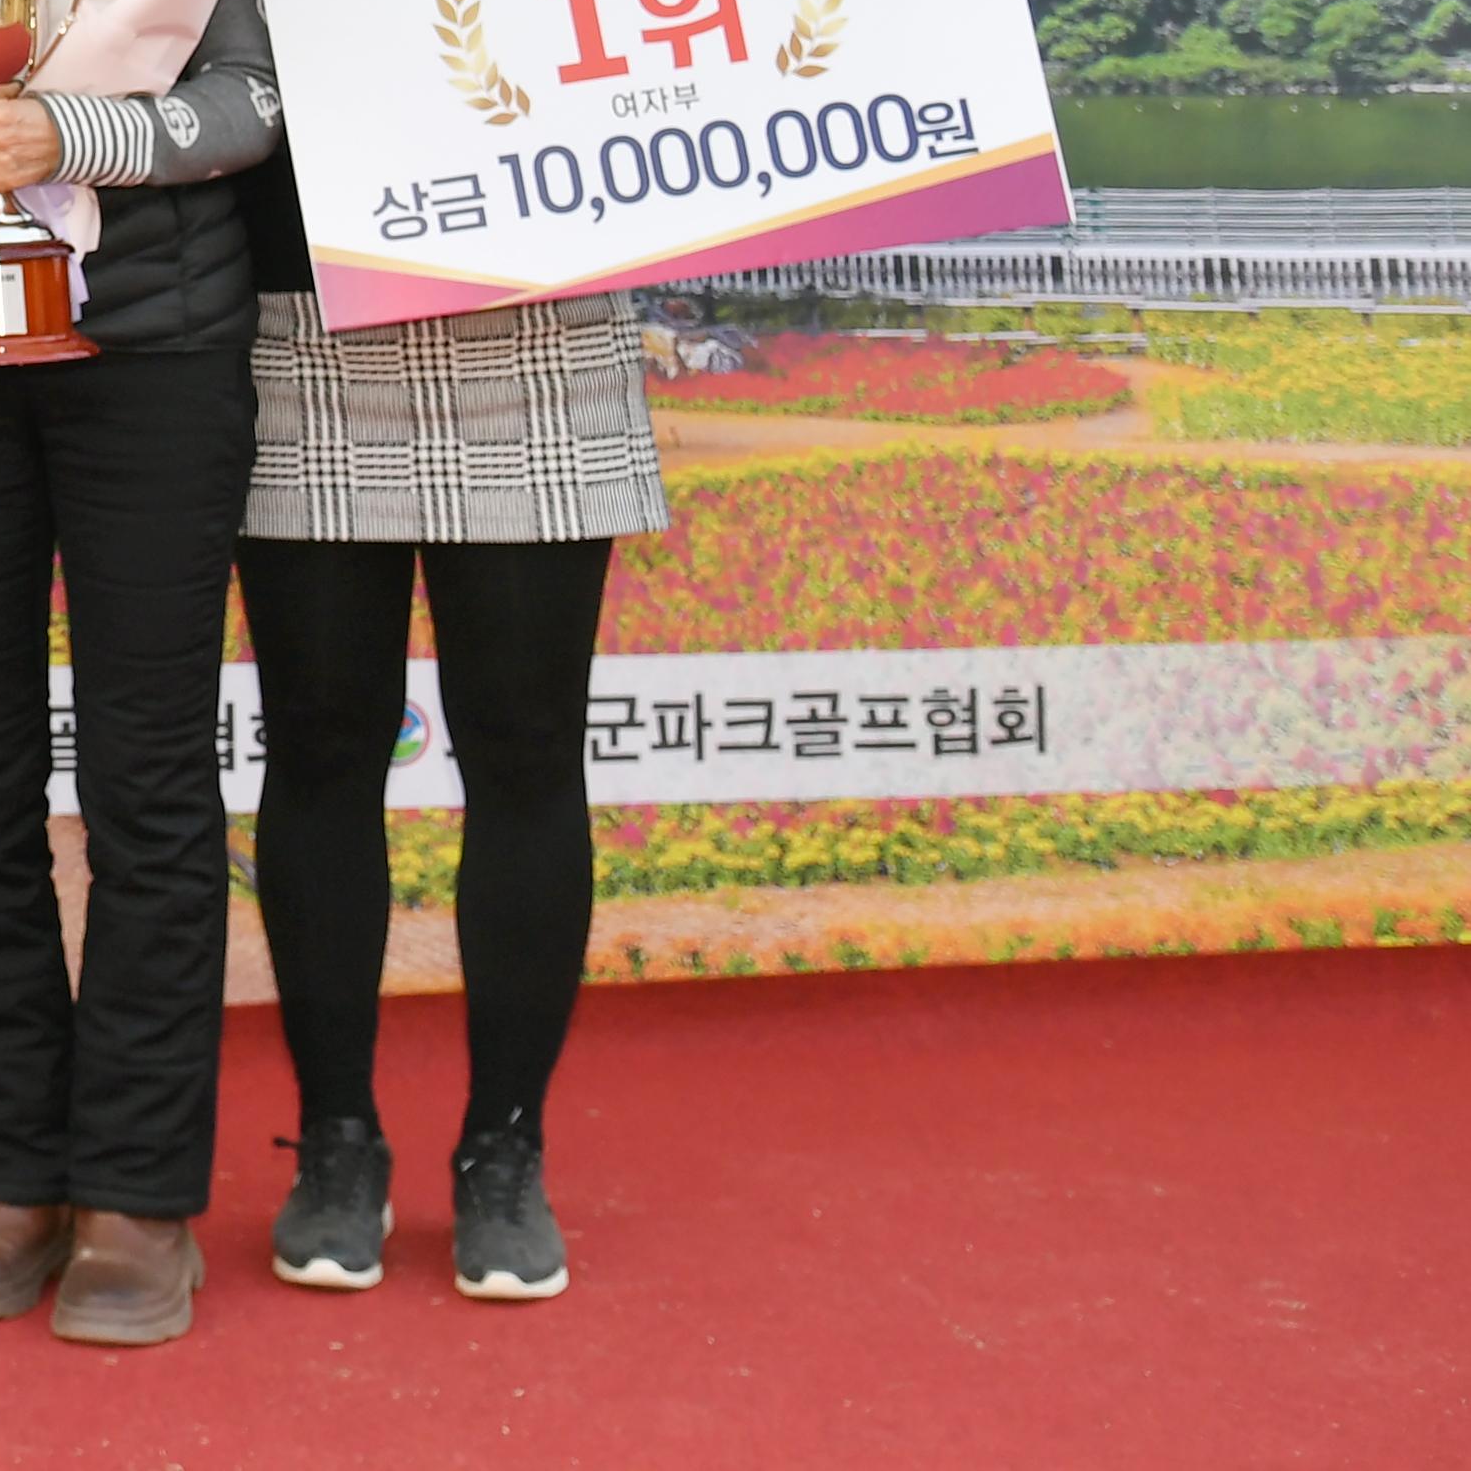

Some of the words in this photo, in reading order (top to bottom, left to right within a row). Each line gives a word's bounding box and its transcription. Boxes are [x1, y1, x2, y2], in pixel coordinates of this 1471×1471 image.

[609, 82, 702, 120] 여자부
[371, 175, 488, 242] 상금
[497, 92, 980, 225] 10,000,000원
